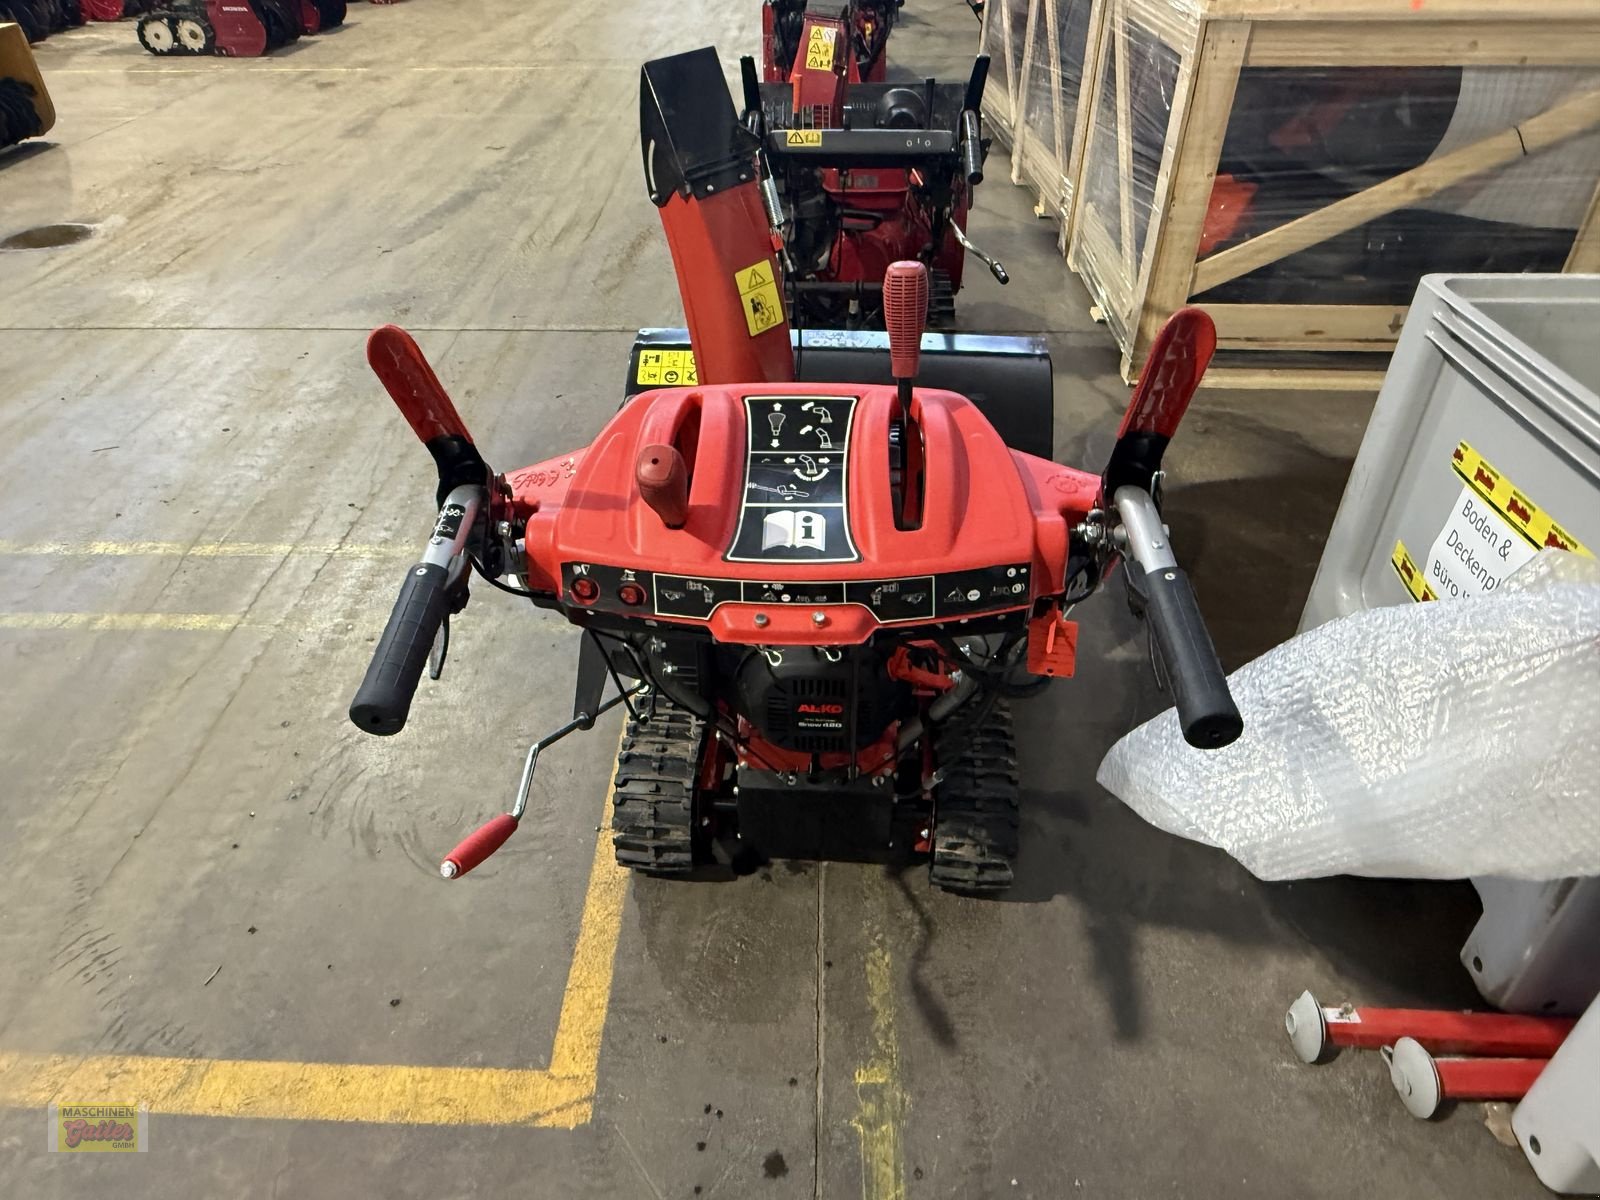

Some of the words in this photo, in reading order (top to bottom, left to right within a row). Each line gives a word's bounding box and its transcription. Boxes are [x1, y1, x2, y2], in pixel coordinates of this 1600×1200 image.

[1461, 499, 1498, 548] Boden
[1498, 538, 1513, 562] &
[1433, 559, 1459, 597] Büro
